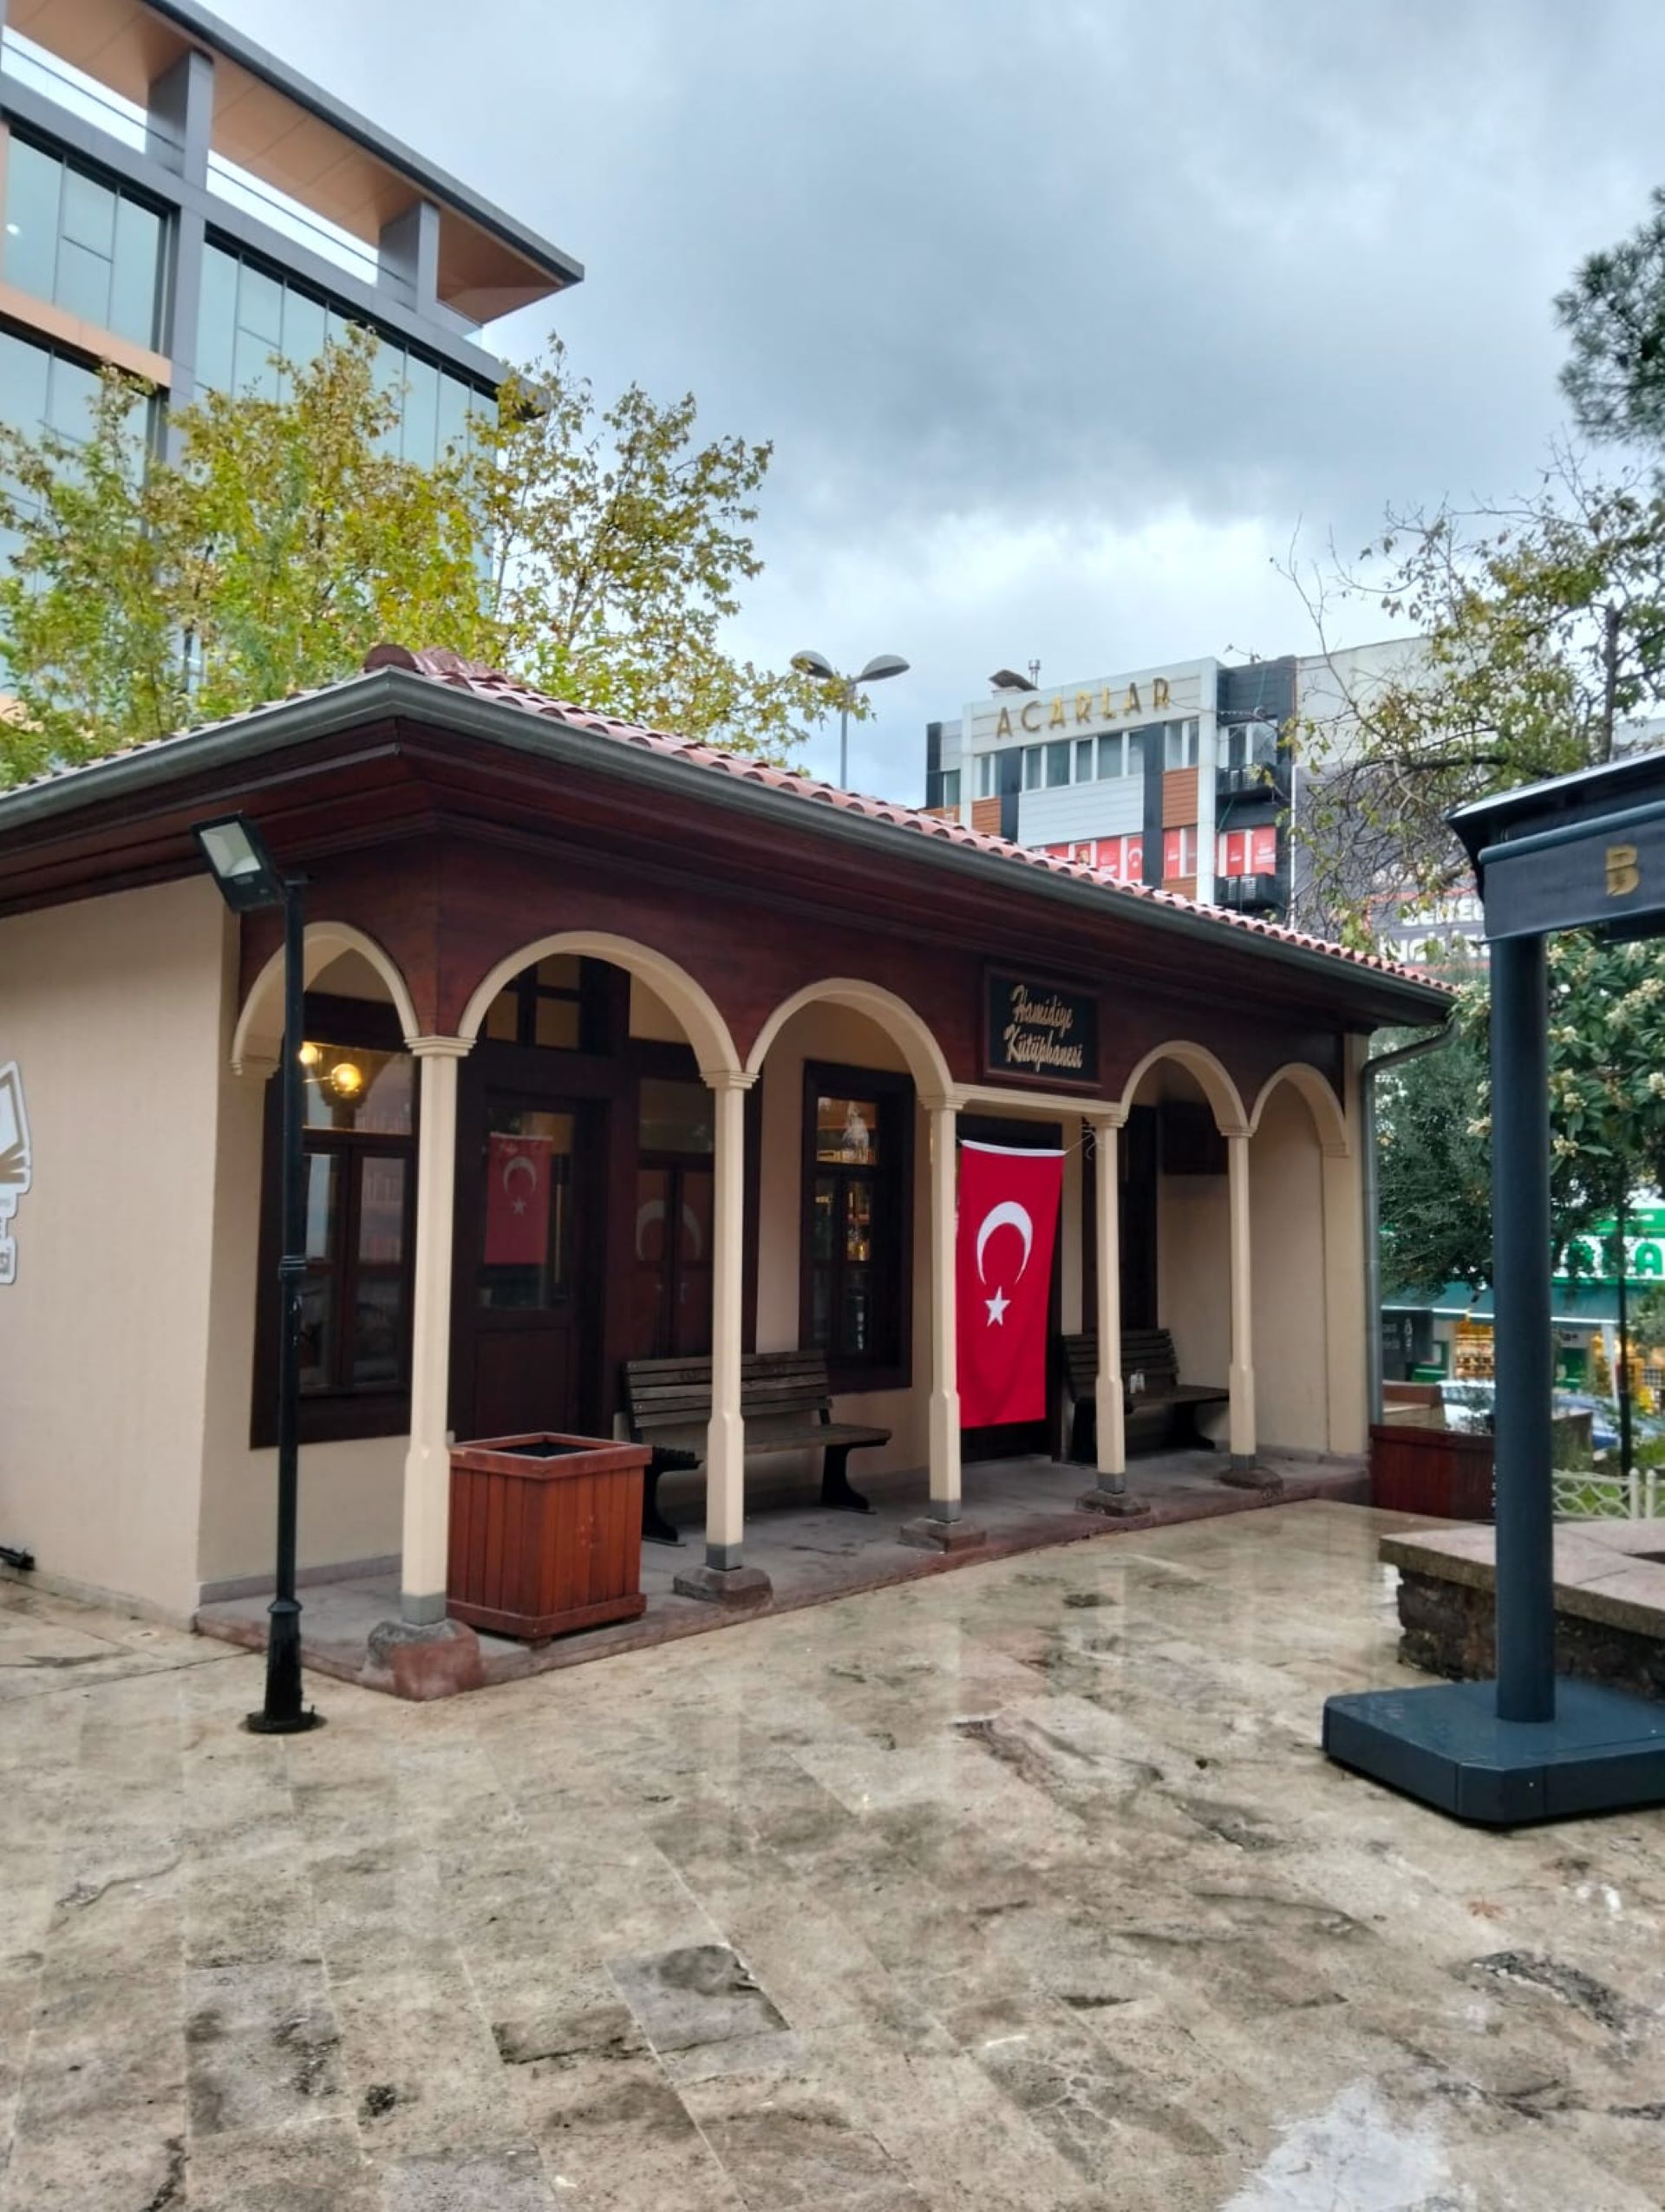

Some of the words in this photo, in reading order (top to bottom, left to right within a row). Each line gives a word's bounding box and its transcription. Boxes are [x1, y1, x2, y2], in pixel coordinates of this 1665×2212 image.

[996, 676, 1172, 739] ACARLAR
[1010, 985, 1074, 1038] Hamidiye
[1003, 1023, 1083, 1073] Kütüphanesi
